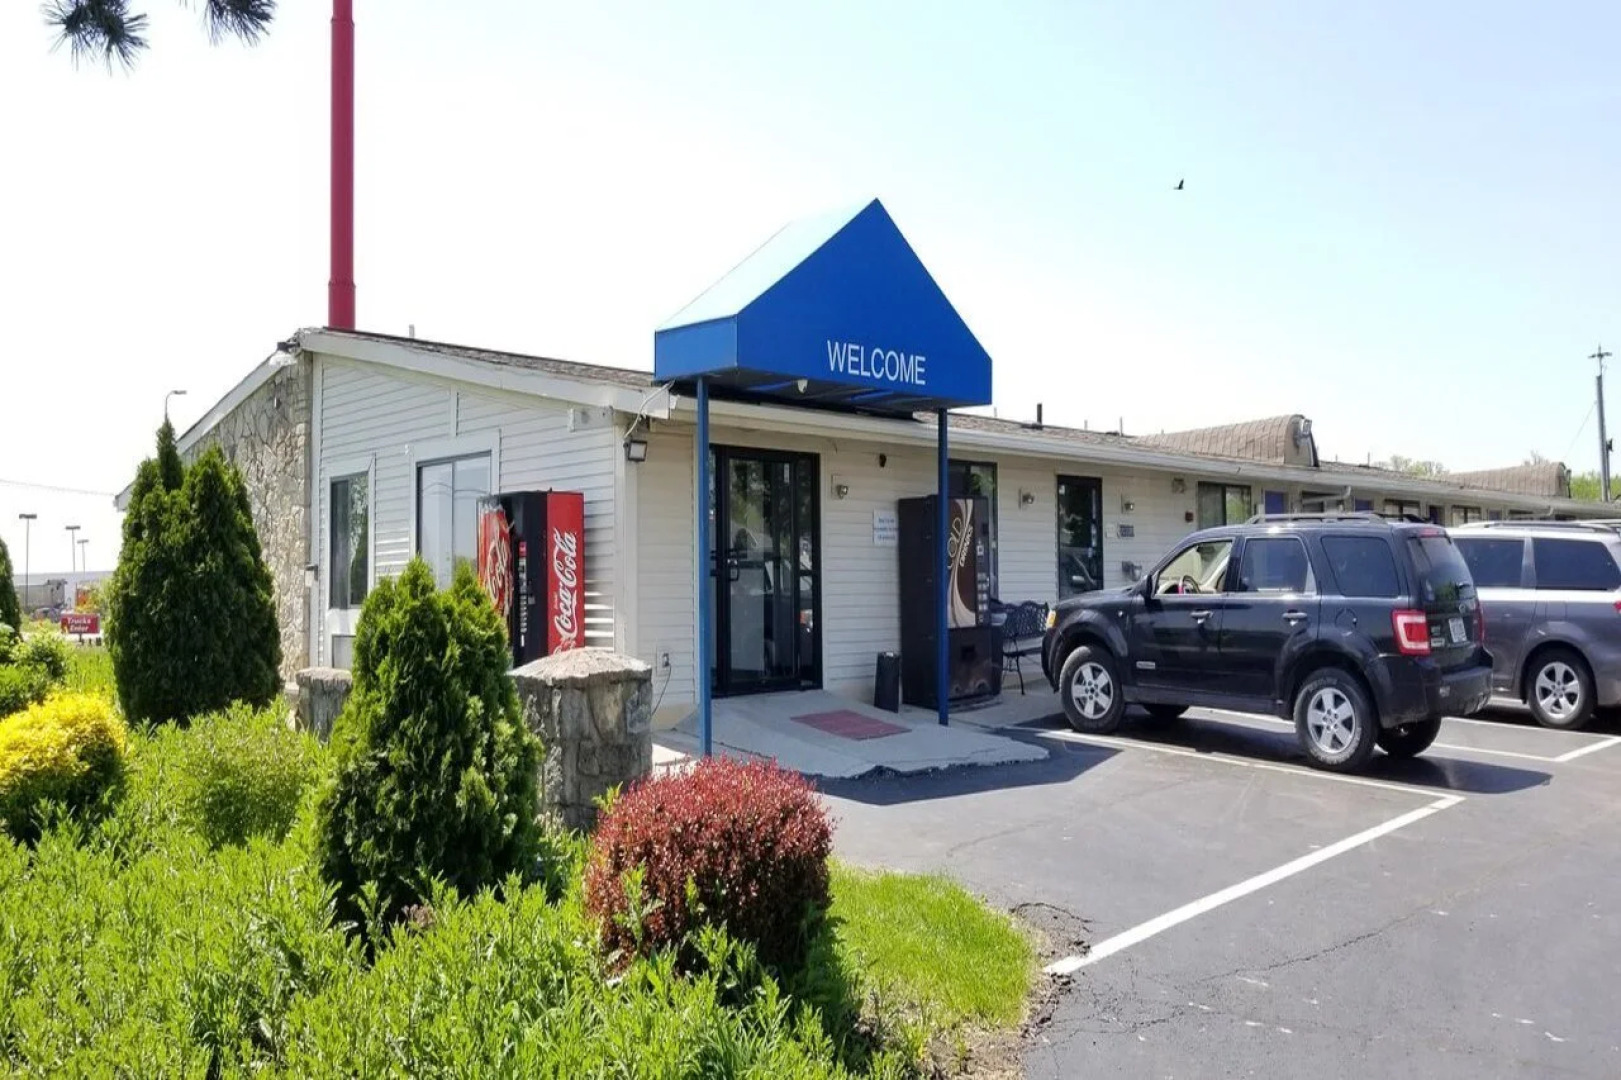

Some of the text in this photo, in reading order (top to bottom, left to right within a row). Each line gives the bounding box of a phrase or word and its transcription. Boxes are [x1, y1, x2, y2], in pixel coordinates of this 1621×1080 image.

[827, 340, 926, 385] WELCOME
[947, 517, 961, 570] OLD
[553, 527, 578, 640] Coca-Cola
